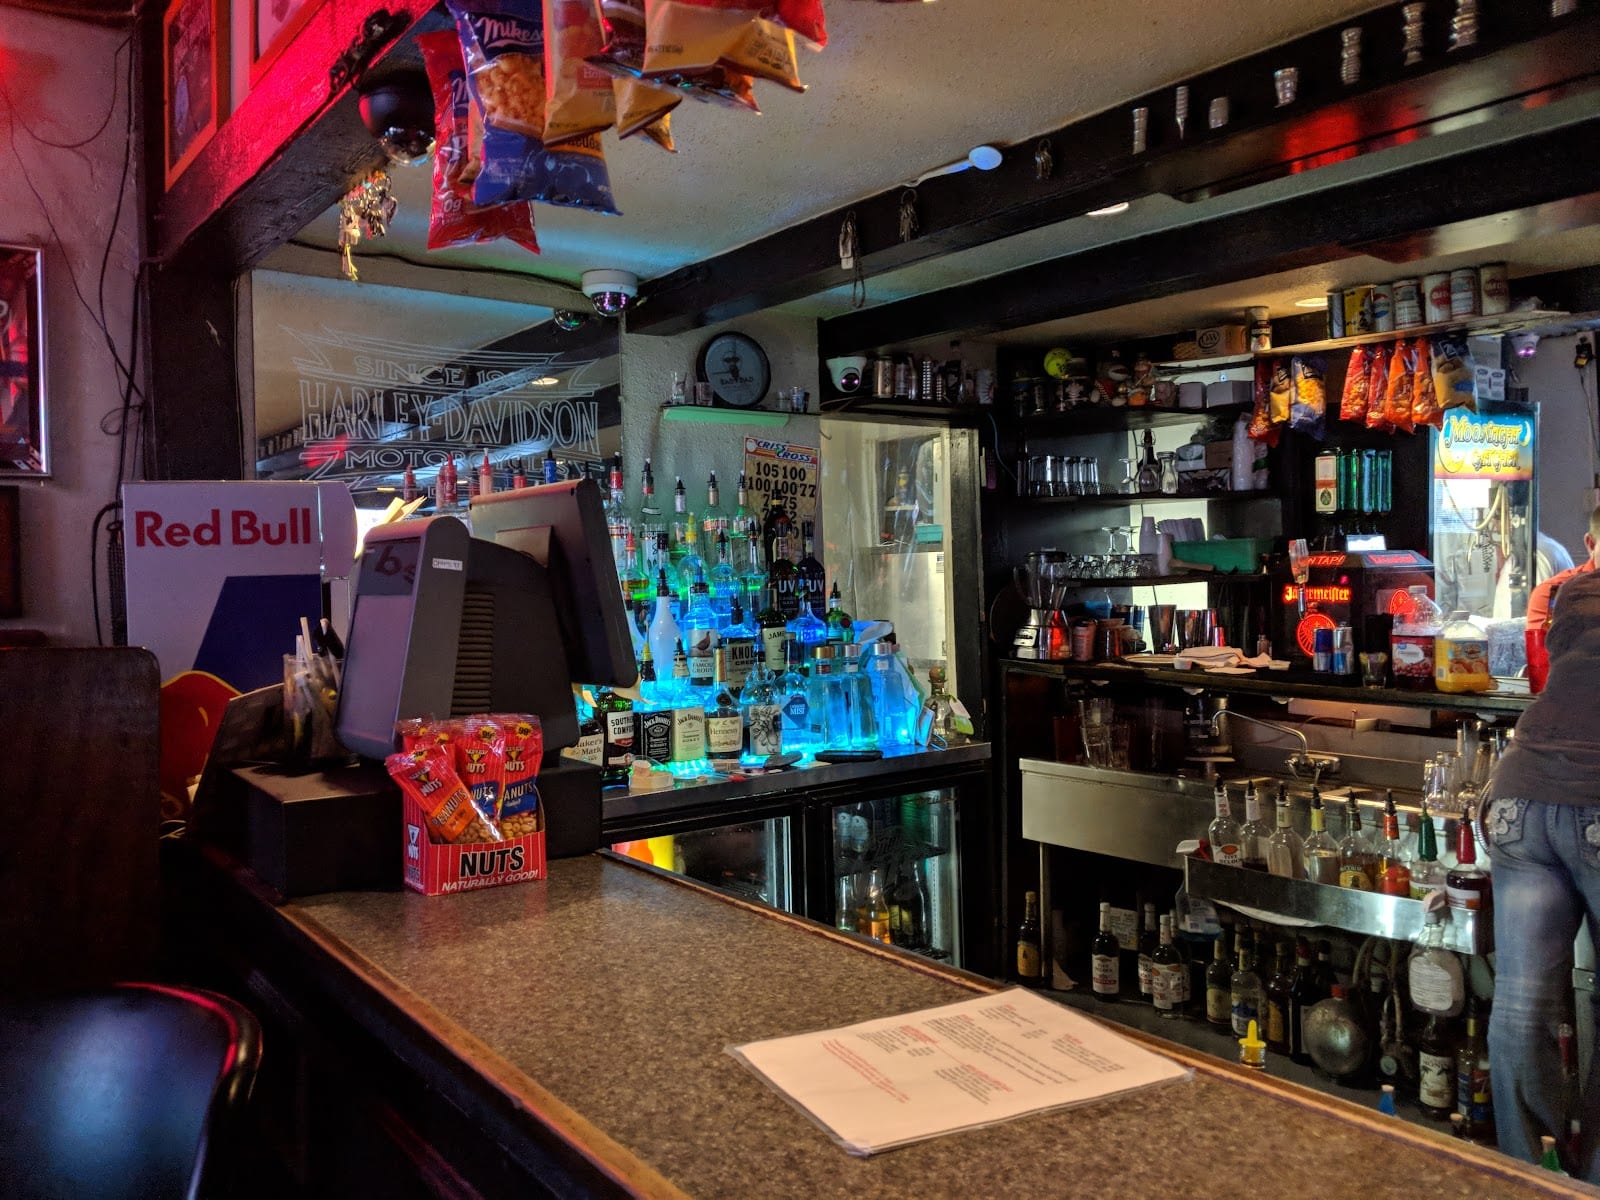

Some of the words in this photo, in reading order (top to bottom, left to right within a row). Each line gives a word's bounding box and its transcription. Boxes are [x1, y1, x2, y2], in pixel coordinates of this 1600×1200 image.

[475, 16, 545, 45] Mikes
[354, 356, 465, 386] SINCE
[299, 379, 602, 454] HARLEY-DAVIDSON
[757, 440, 788, 452] CRISS
[777, 450, 812, 463] CROSS
[756, 462, 779, 478] 105
[783, 466, 806, 482] 100
[748, 477, 771, 492] 100
[774, 480, 797, 495] 100
[800, 485, 817, 498] 77
[135, 509, 221, 546] Red
[231, 509, 312, 545] Bull
[1318, 554, 1347, 566] TAP!
[779, 580, 796, 593] UV
[809, 580, 825, 593] UV
[767, 631, 785, 641] JAME
[577, 739, 603, 748] aker's
[420, 778, 443, 797] NUTS
[503, 783, 534, 800] ANUTS
[460, 847, 526, 878] NUTS
[441, 874, 503, 892] NATURALLY
[505, 869, 539, 883] GOOD!
